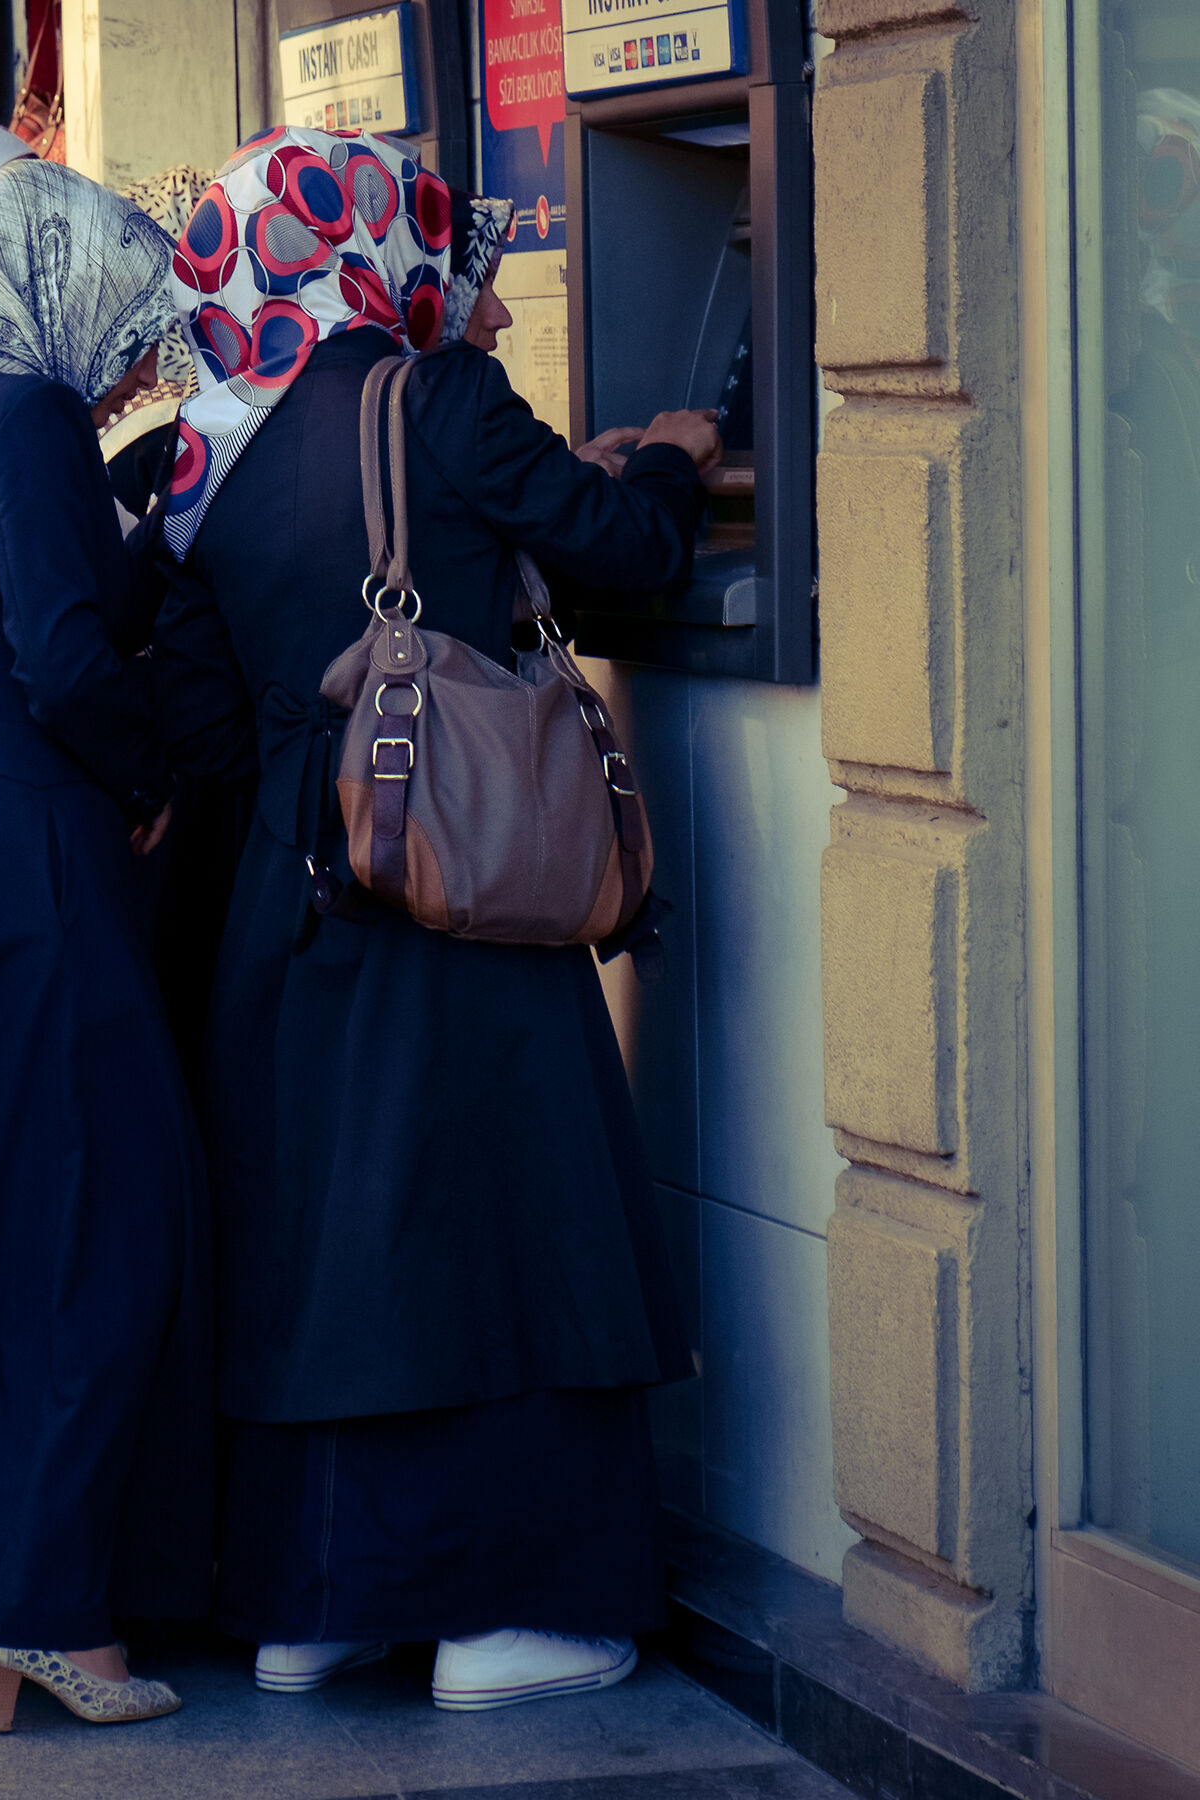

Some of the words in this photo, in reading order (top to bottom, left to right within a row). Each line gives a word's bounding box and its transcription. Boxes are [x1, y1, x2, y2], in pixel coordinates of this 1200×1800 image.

[299, 38, 344, 84] INSTANT
[347, 30, 379, 72] CASH
[487, 28, 539, 67] BANKACILIK
